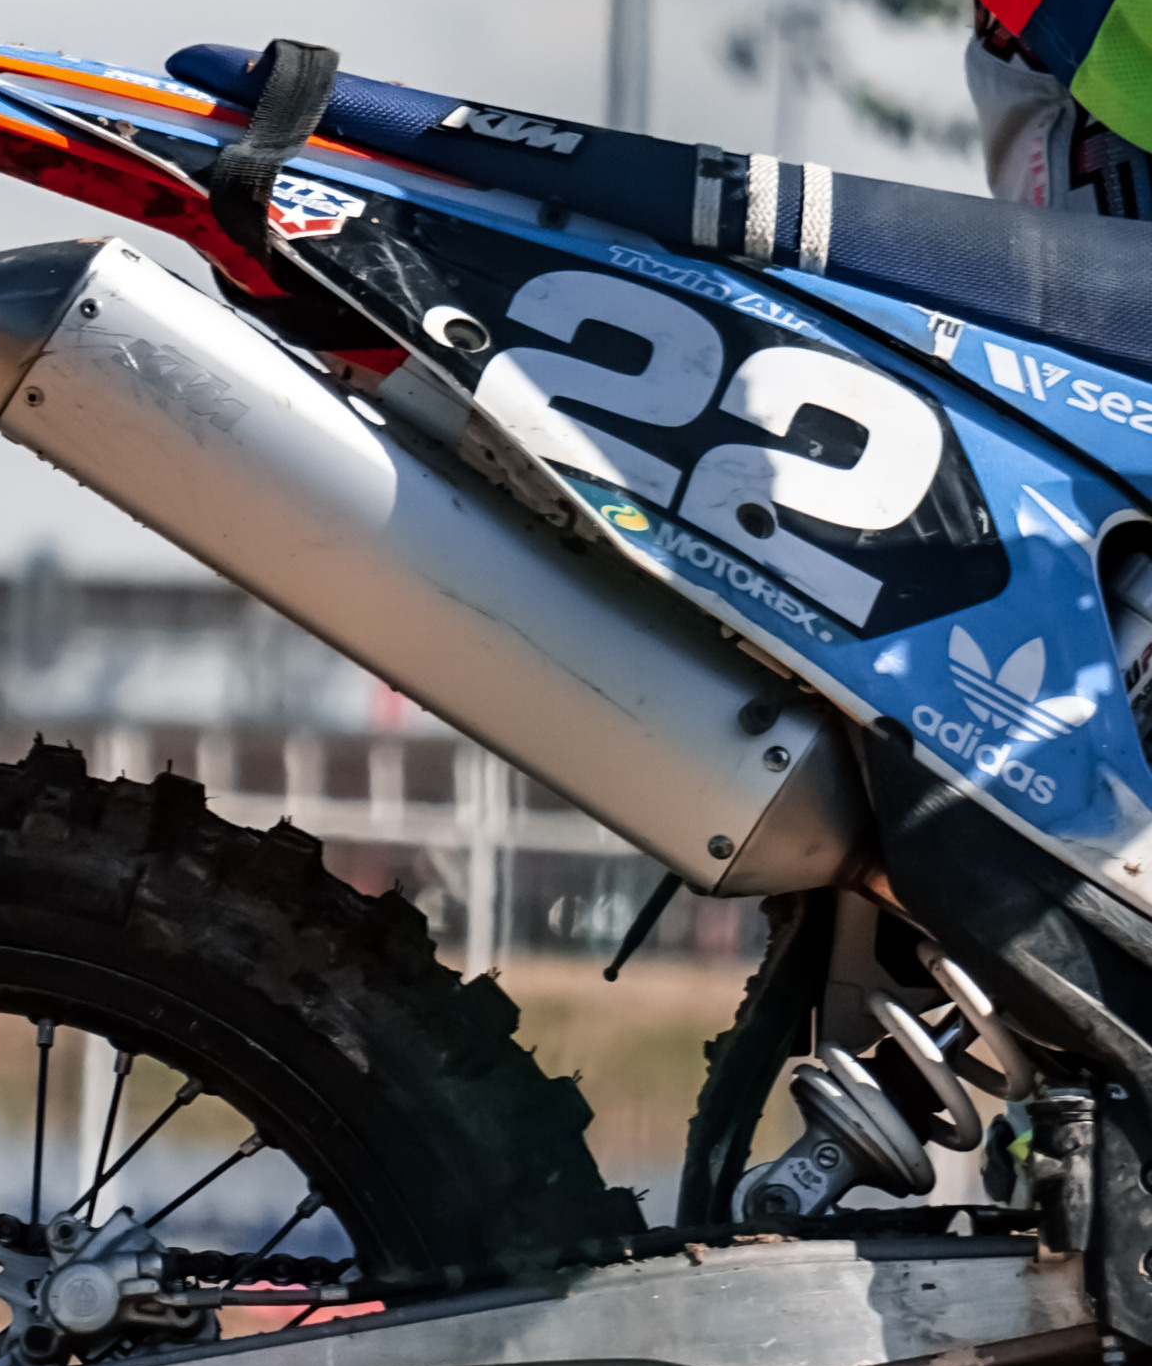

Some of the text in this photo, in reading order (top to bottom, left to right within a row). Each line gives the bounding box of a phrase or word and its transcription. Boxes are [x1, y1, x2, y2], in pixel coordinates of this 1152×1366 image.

[441, 105, 584, 154] KTM
[609, 245, 820, 331] Twin Air
[474, 270, 943, 629] 22
[653, 522, 820, 637] MOTOREX
[912, 704, 1057, 804] adidas
